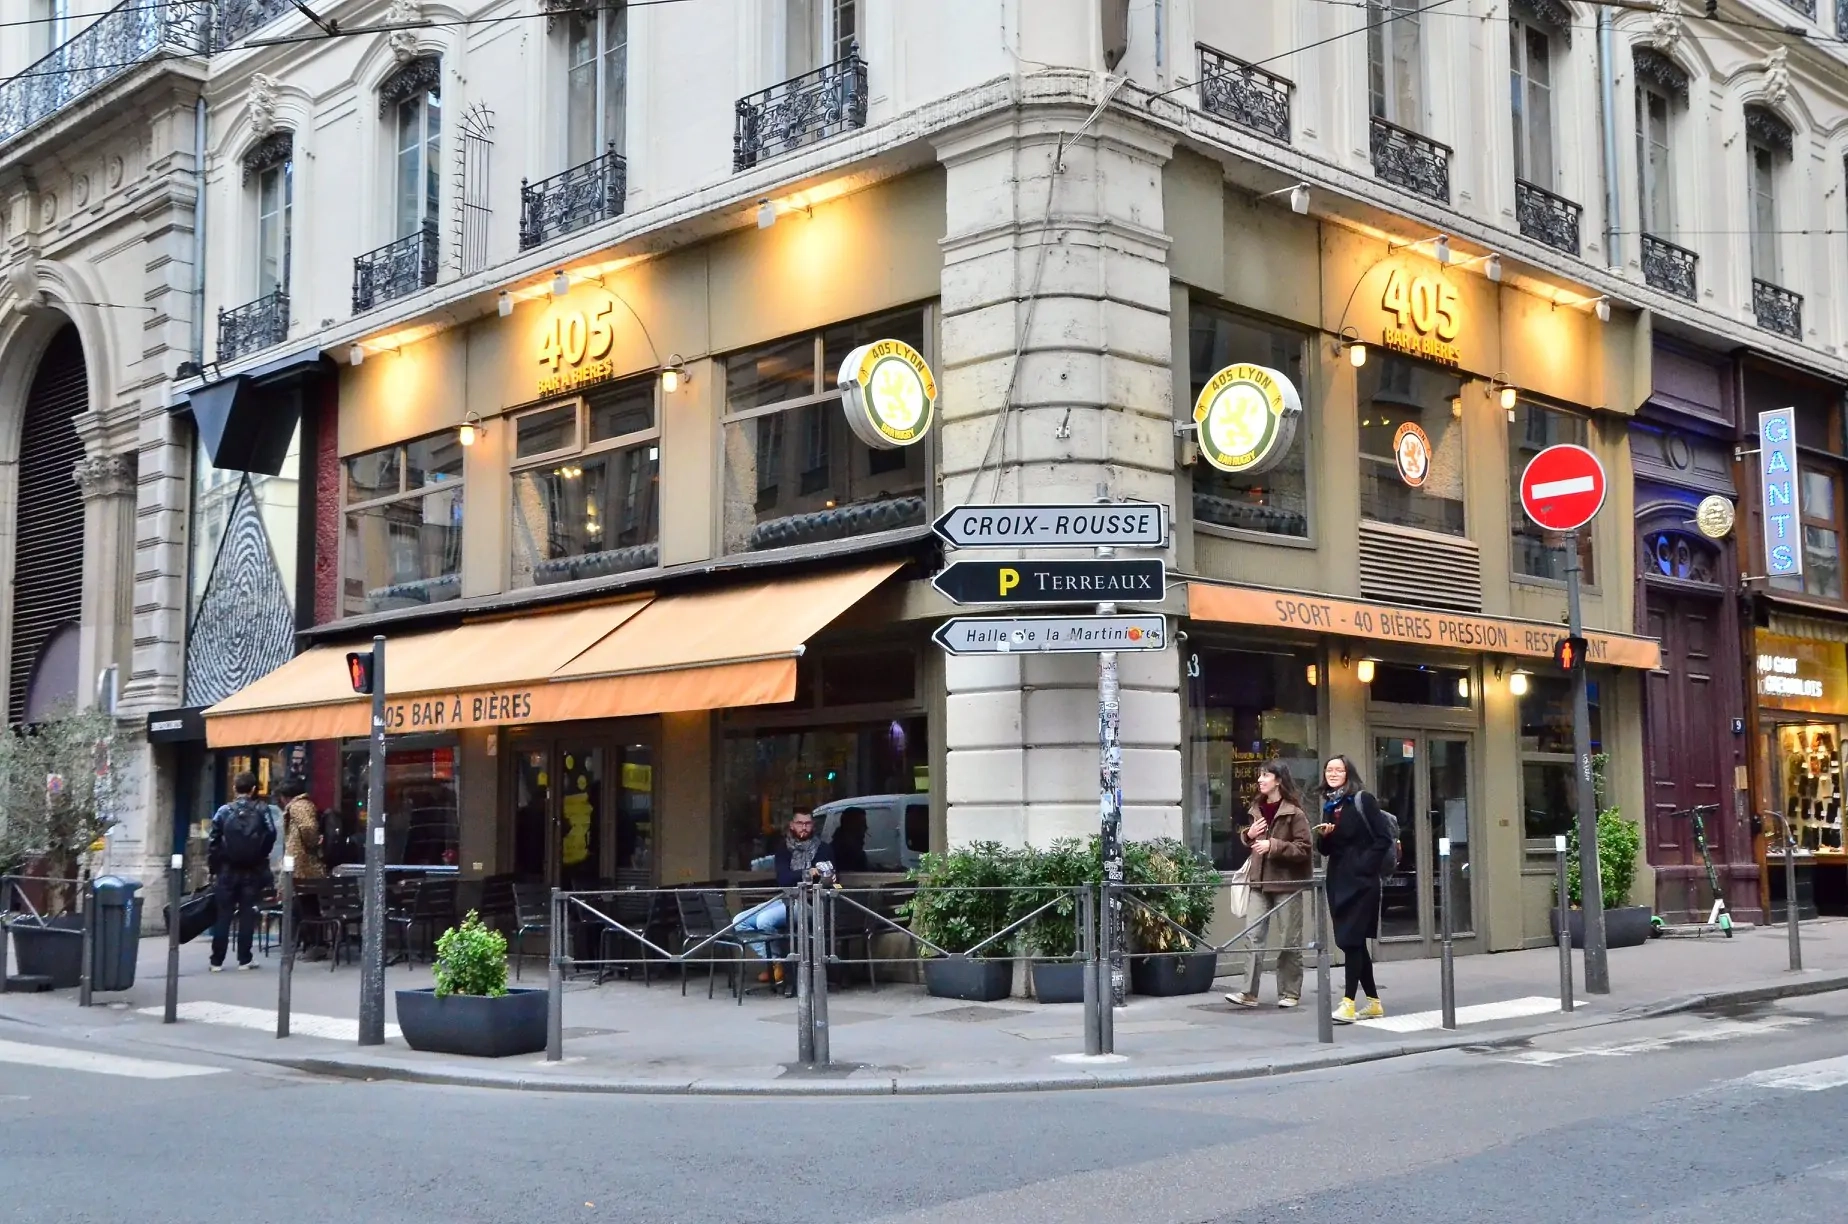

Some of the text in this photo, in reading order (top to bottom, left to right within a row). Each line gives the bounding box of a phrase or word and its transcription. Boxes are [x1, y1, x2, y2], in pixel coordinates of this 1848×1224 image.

[1382, 268, 1461, 343] 405
[538, 299, 614, 373] 405
[872, 343, 925, 373] 405 LYON
[1212, 367, 1272, 391] 405 LYON
[1765, 417, 1792, 570] GANTS
[963, 514, 1150, 536] CROIX-ROUSSE
[1000, 568, 1152, 596] P TERREAUX
[966, 629, 1007, 642] Halle
[1046, 628, 1060, 641] la
[1071, 627, 1153, 641] Martinie
[1275, 600, 1332, 628] SPORT
[1354, 611, 1374, 633] 40
[1380, 611, 1432, 640] BIÈRES
[1438, 619, 1508, 648] PRESSION
[1525, 630, 1608, 659] RESTANT
[384, 691, 531, 727] 05 BAR À BIÈRES
[1735, 720, 1742, 730] 9
